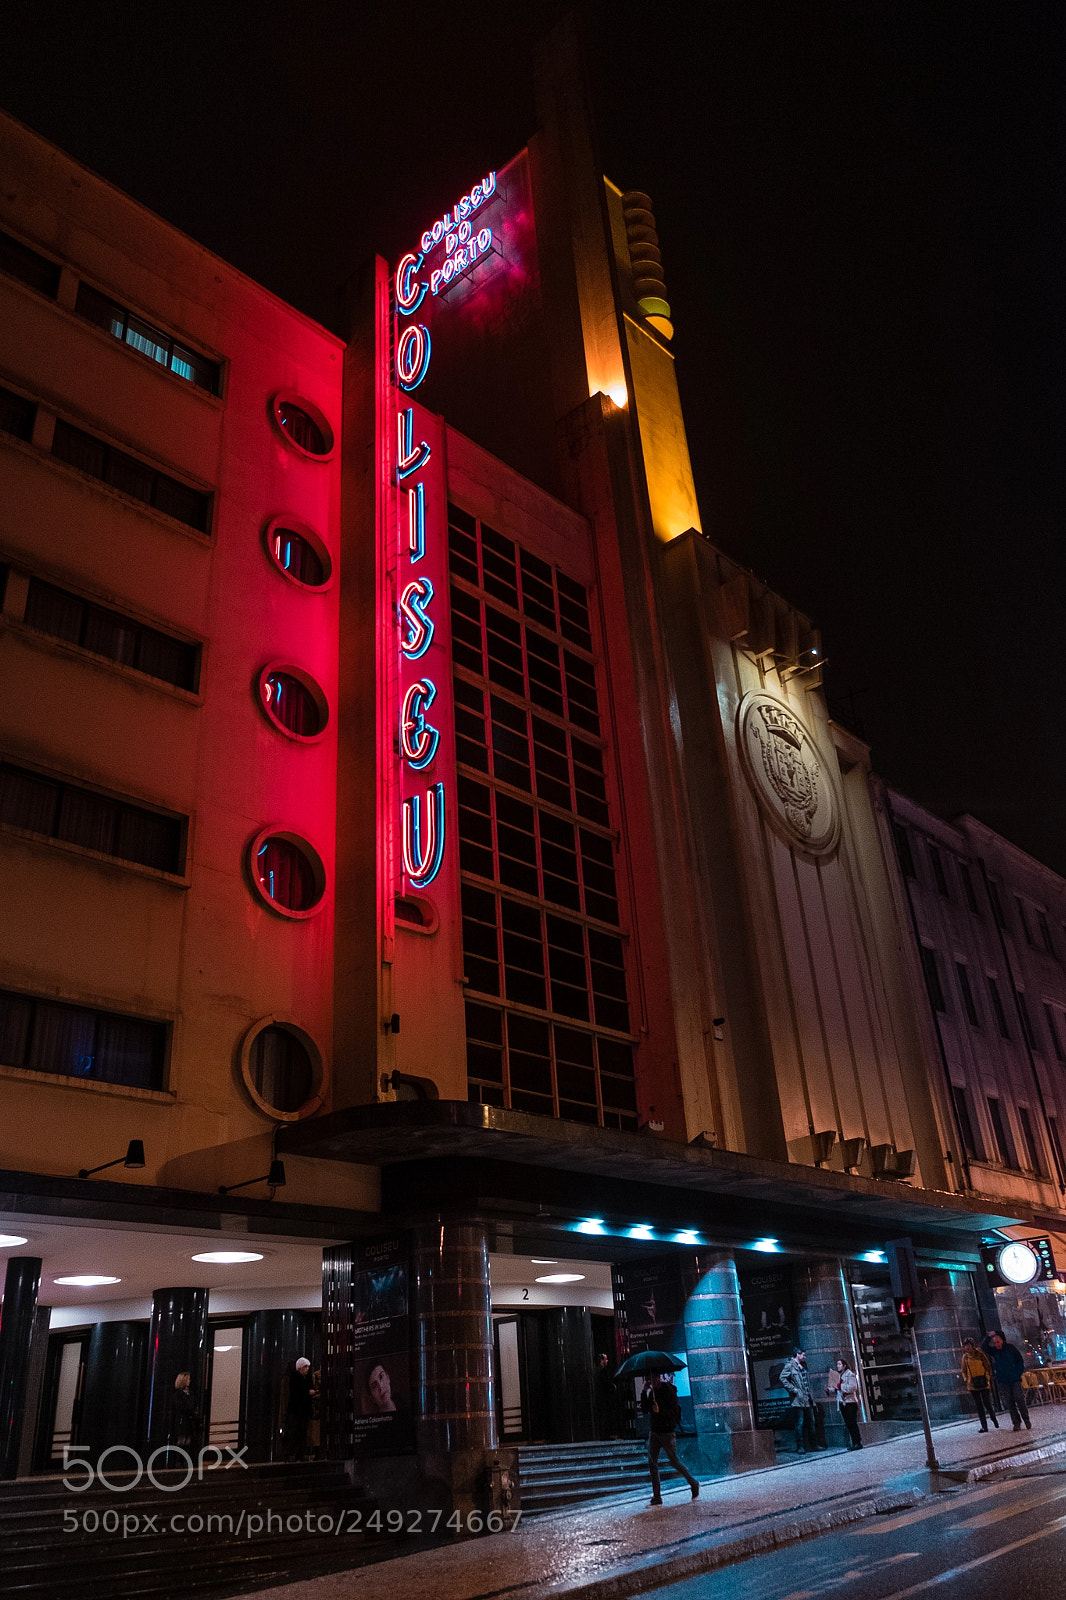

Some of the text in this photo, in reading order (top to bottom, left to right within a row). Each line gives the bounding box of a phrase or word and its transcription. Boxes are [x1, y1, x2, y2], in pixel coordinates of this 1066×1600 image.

[421, 171, 496, 253] COLISEU
[446, 221, 472, 258] DO
[431, 228, 492, 296] PORTO
[396, 253, 445, 890] COLISEU
[365, 1240, 399, 1257] COLISEU
[522, 1288, 529, 1300] 2
[751, 1273, 783, 1285] COLISEU
